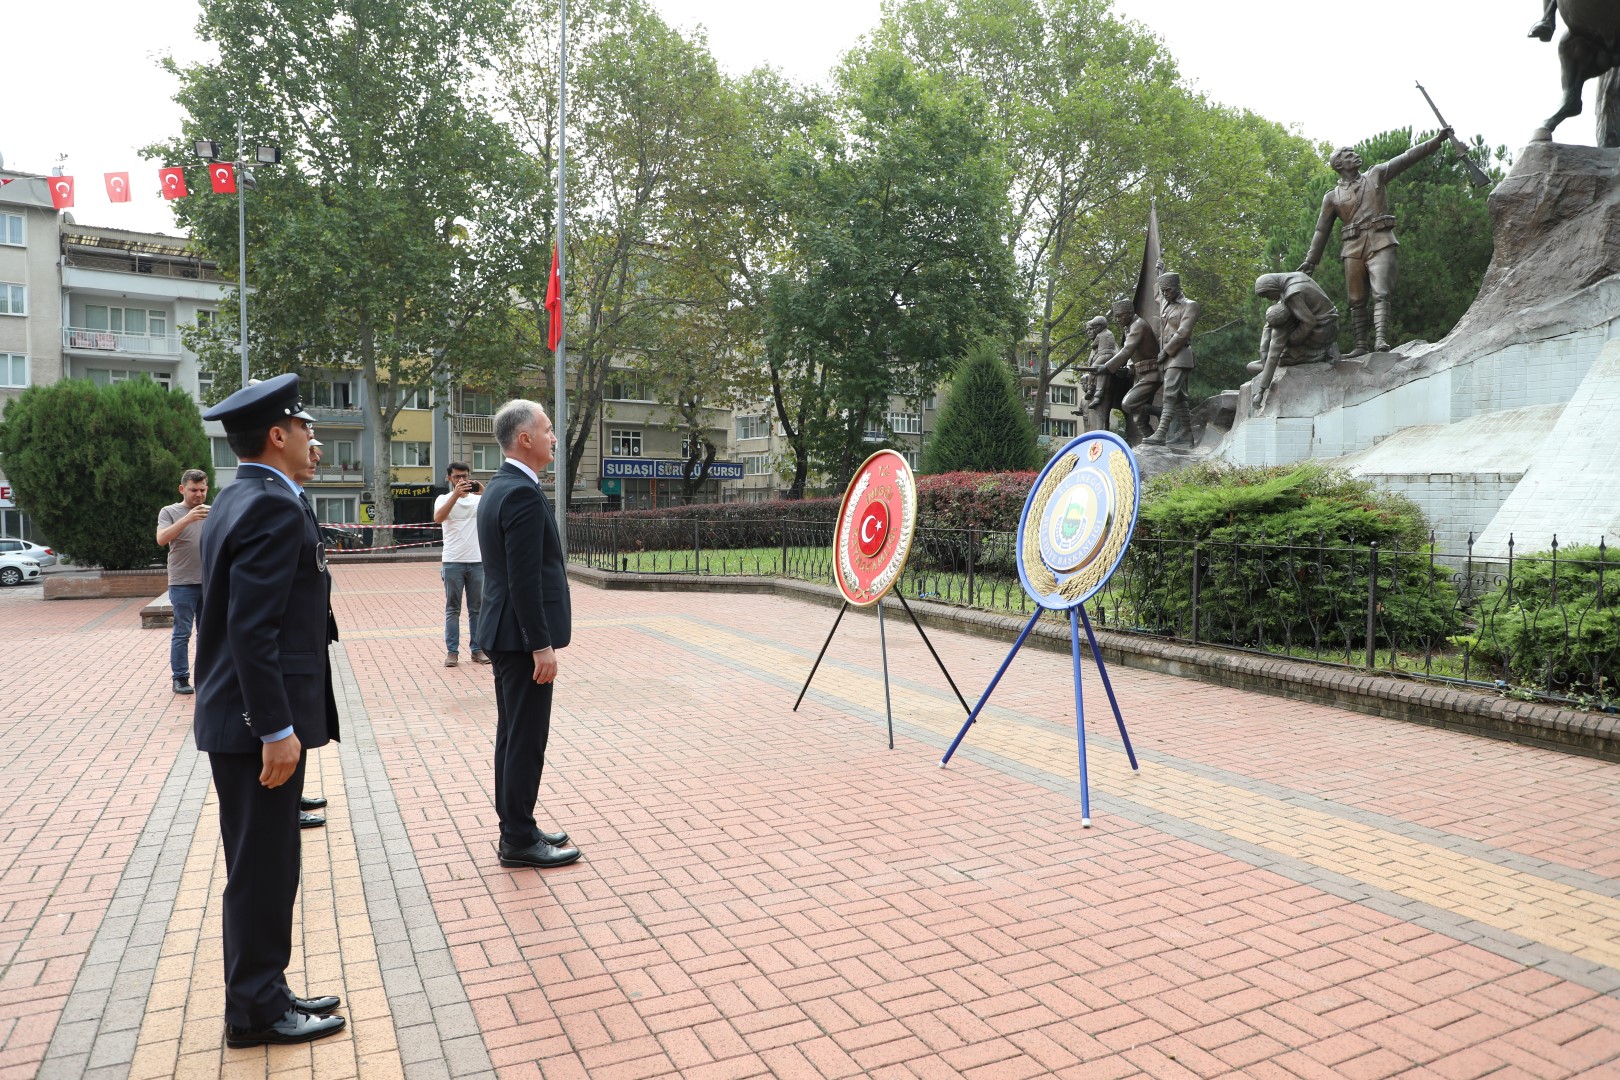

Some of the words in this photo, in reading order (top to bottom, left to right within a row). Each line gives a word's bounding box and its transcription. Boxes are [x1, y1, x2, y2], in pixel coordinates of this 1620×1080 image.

[606, 464, 653, 477] SUBAŞI
[657, 463, 701, 477] SÜRÜÜ
[709, 466, 741, 477] KURSU
